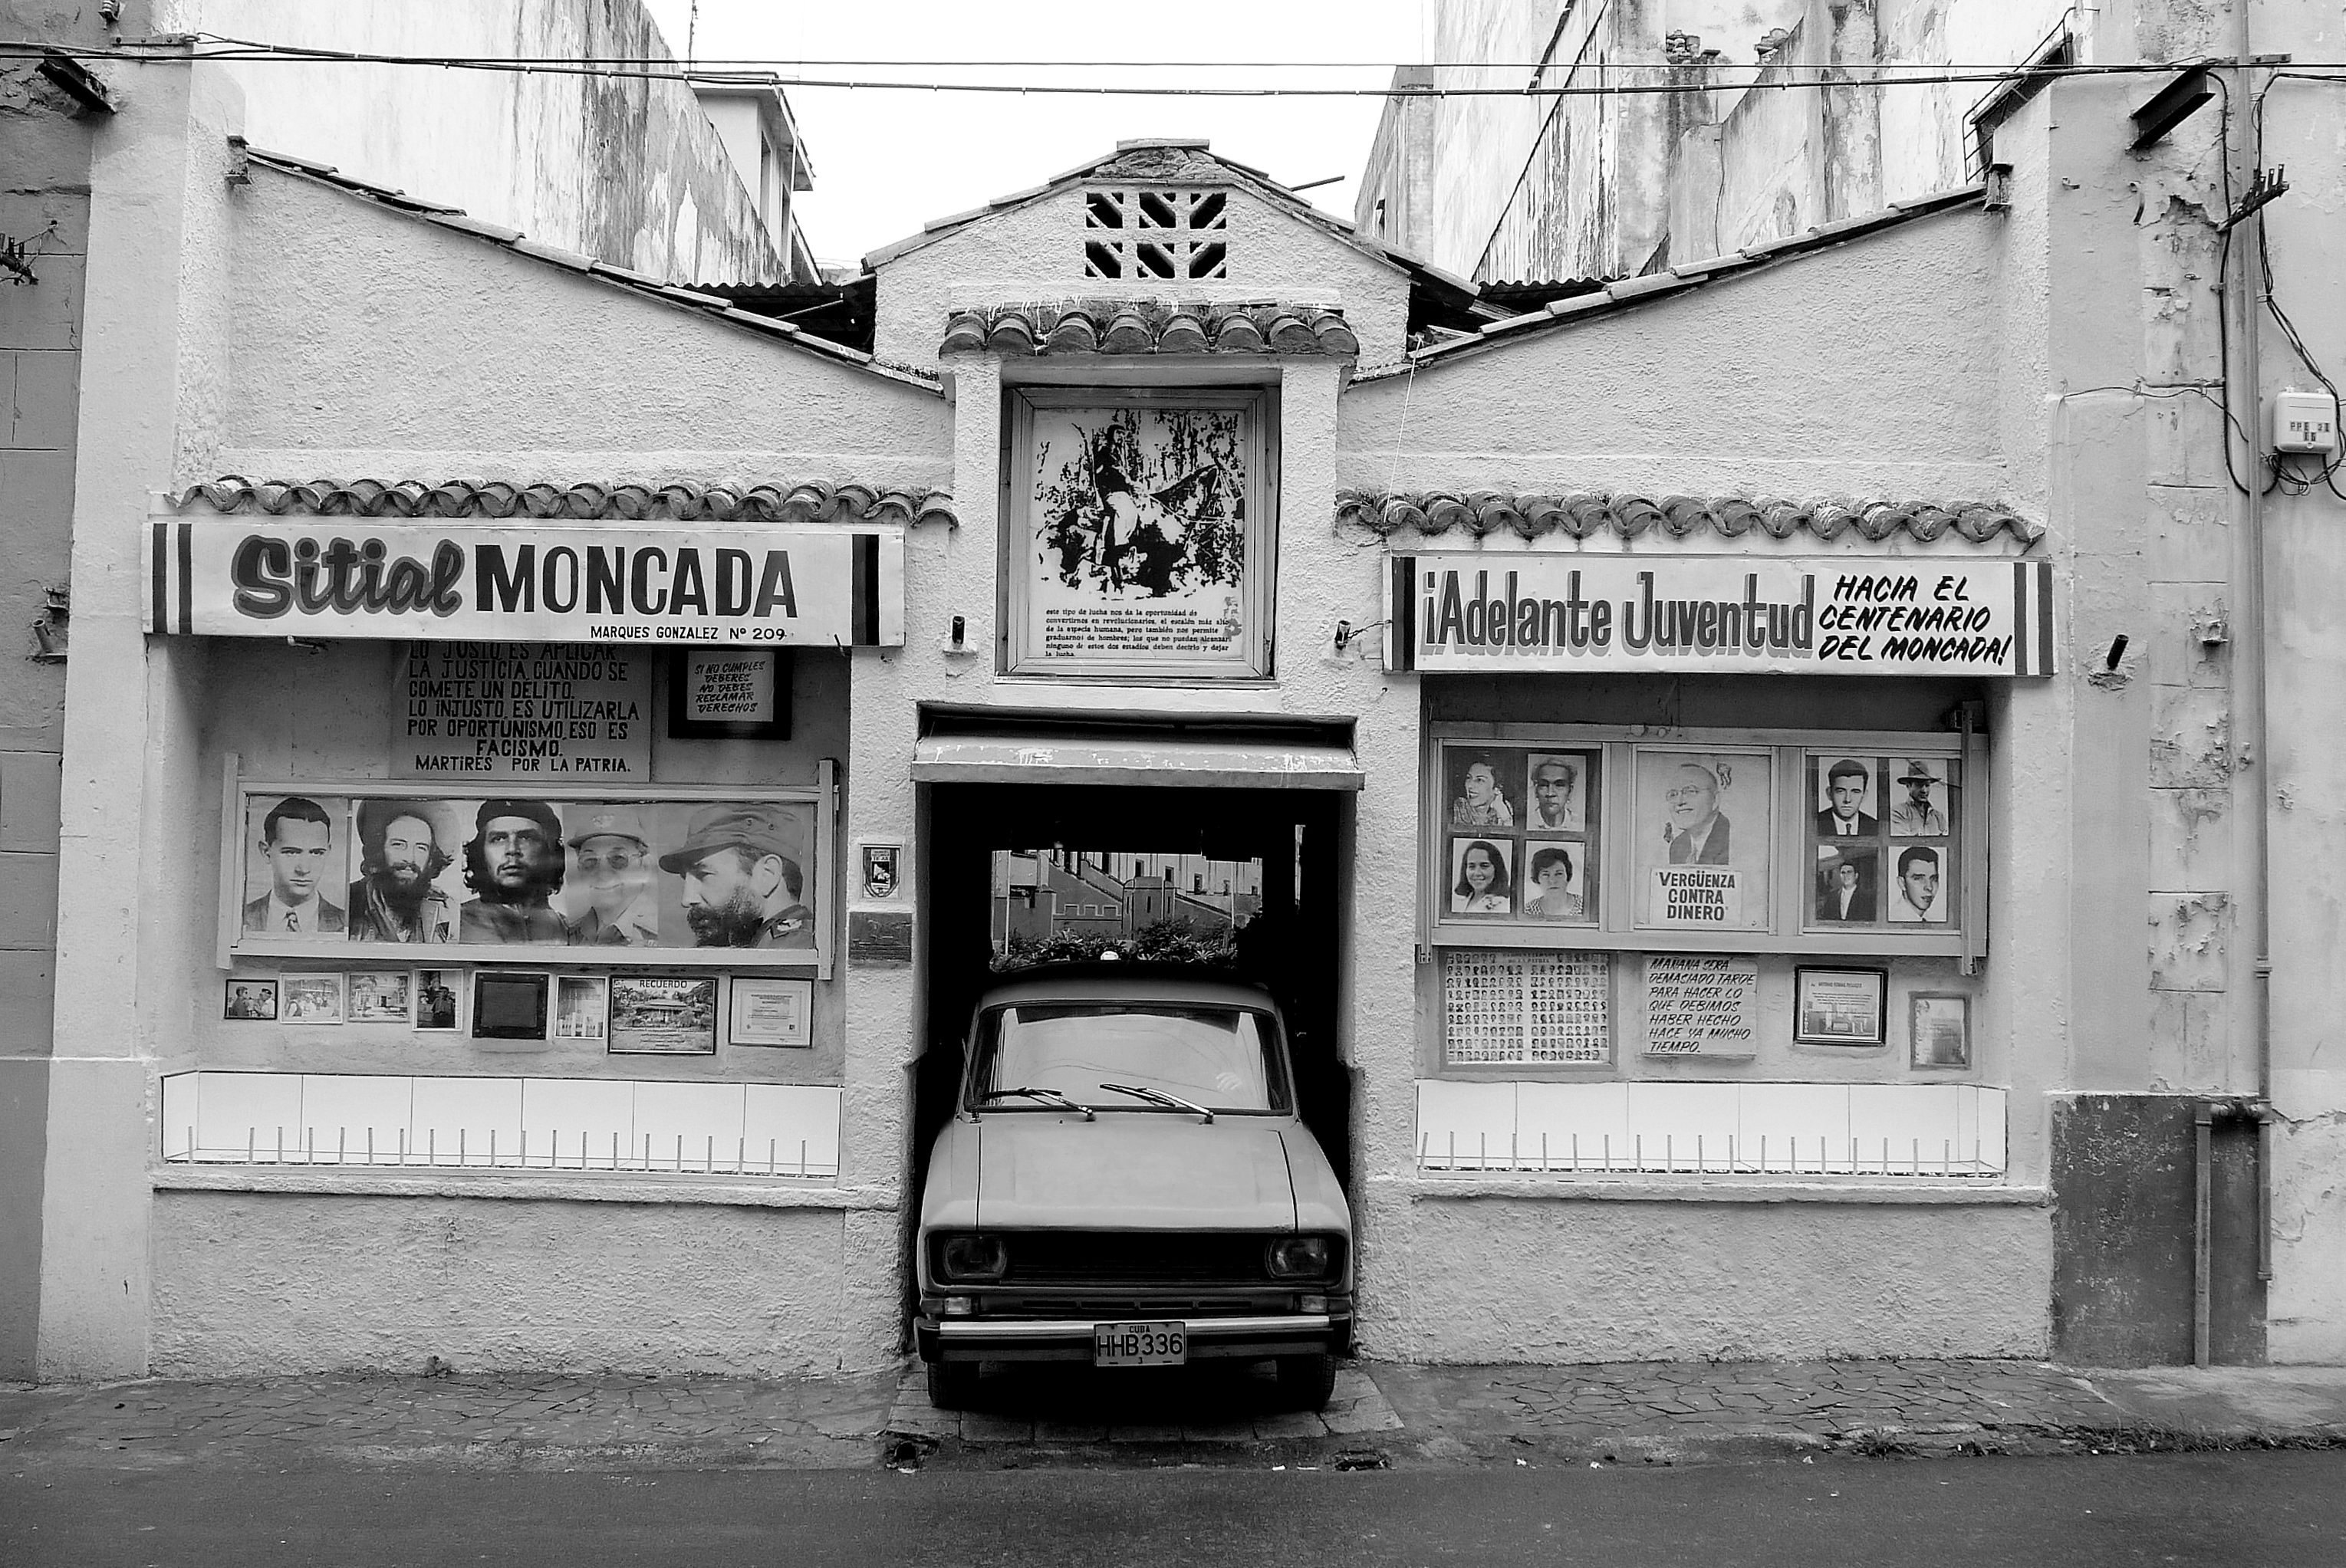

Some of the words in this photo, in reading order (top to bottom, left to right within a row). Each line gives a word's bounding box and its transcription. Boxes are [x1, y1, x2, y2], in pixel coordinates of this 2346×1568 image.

[232, 534, 466, 619] Sitial
[475, 544, 799, 619] MONCADA
[1833, 574, 1918, 603] HACIA
[1933, 575, 1969, 602] EL
[1623, 570, 1816, 659] Juventud
[1818, 603, 1991, 633] CENTENARIO
[590, 626, 650, 639] MARQUES
[656, 626, 719, 639] GONZALEZ
[409, 641, 429, 659] LO
[509, 642, 530, 659] ES
[539, 643, 617, 661] APLICAR
[1818, 635, 1874, 661] DEL
[1880, 635, 2013, 666] MONCADA!
[409, 660, 431, 679] LA
[533, 661, 603, 681] CUANDO
[608, 662, 628, 682] SE
[694, 663, 705, 675] SI
[706, 663, 719, 674] NO
[722, 661, 765, 673] CUMPLES
[705, 673, 752, 683] DEBERES
[408, 680, 475, 699] COMETE
[481, 681, 504, 699] UN
[699, 684, 715, 693] NO
[718, 682, 753, 692] DEBES
[696, 692, 755, 703] RECLAMAR
[409, 699, 427, 718] LO
[513, 700, 534, 718] ES
[541, 700, 640, 721] UTILIZARLA
[697, 702, 758, 714] DERECHOS
[407, 719, 438, 736] POR
[569, 721, 597, 740] ESO
[608, 722, 628, 740] ES
[476, 739, 564, 758] FACISMO.
[512, 758, 540, 772] POR
[551, 758, 569, 772] LA
[575, 758, 631, 773] PATRIA.
[1668, 889, 1724, 905] CONTRA
[1650, 957, 1701, 971] MAÑANA
[639, 978, 688, 989] RECUERDO
[1649, 972, 1715, 985] DEMASIADO
[1717, 973, 1757, 985] TARDE
[1649, 986, 1680, 998] PARA
[1684, 987, 1723, 998] HACER
[1726, 988, 1743, 998] LO
[1648, 1000, 1676, 1011] QUE
[1680, 1000, 1742, 1012] DEBIMOS
[1649, 1014, 1693, 1026] HABER
[1696, 1014, 1742, 1027] HECHO
[1649, 1027, 1684, 1039] HACE
[1688, 1027, 1704, 1039] YA
[1706, 1028, 1752, 1040] MUCHO
[1650, 1040, 1702, 1053] TIEMPO.
[1129, 1325, 1150, 1333] CUBA
[1097, 1333, 1183, 1357] HHB336
